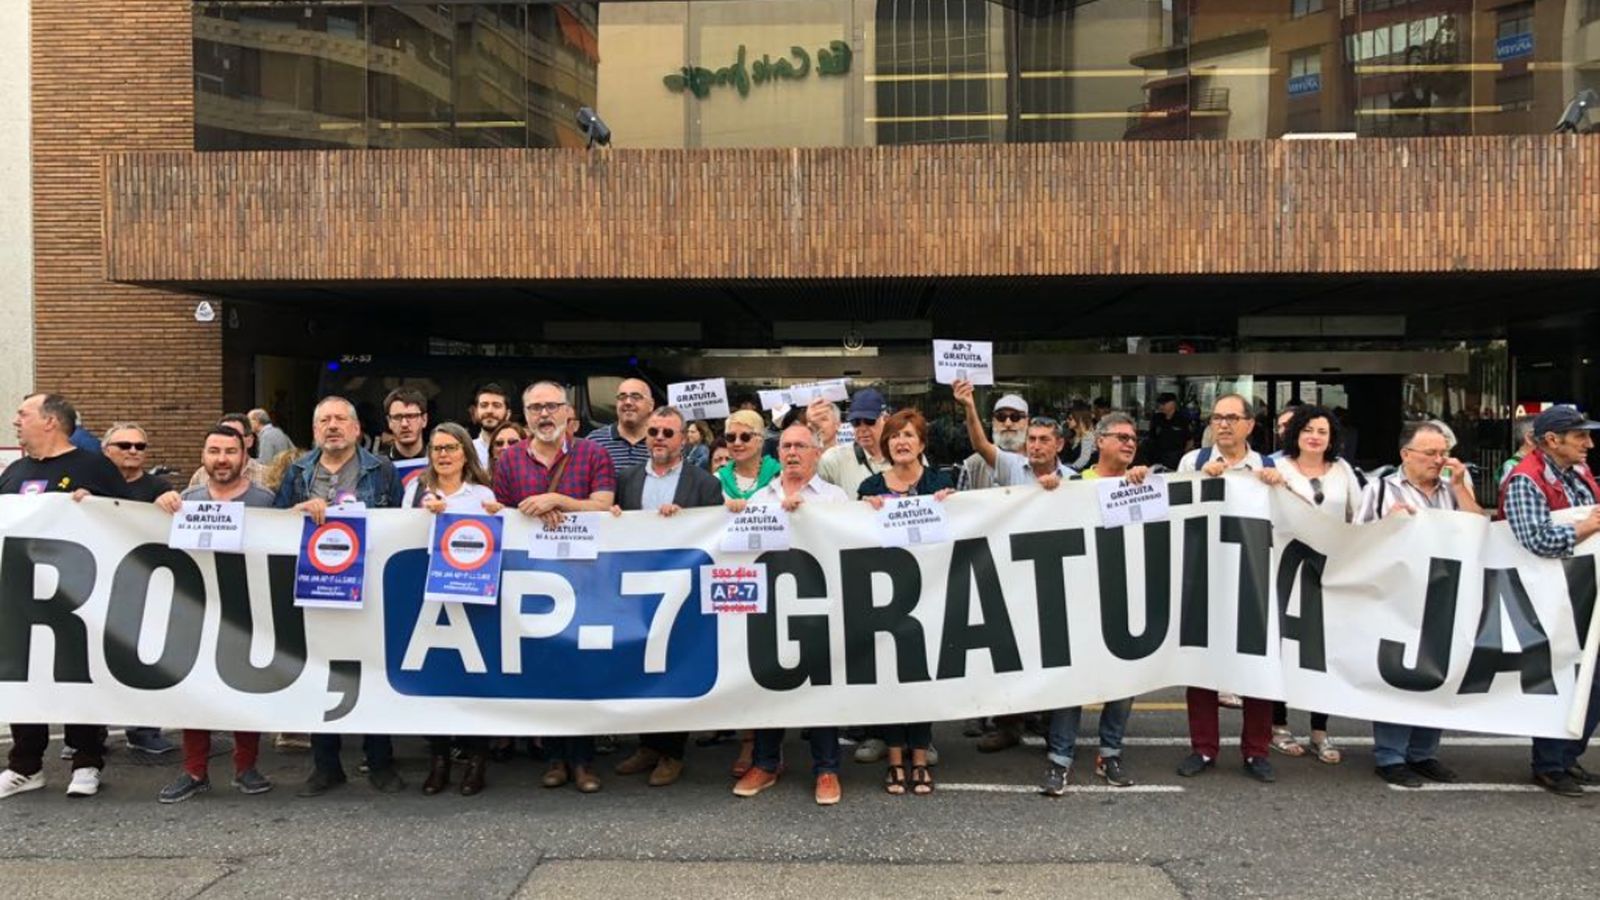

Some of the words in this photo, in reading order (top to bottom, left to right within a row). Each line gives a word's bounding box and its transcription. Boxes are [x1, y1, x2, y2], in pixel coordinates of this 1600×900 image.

[952, 343, 972, 351] AP-7
[684, 382, 705, 392] AP-7
[197, 503, 222, 512] AP-7
[897, 499, 920, 509] AP-7
[744, 505, 768, 514] AP-7
[400, 568, 692, 675] AP-7
[747, 478, 1327, 692] GRATUÏTA
[713, 584, 755, 599] AP-7
